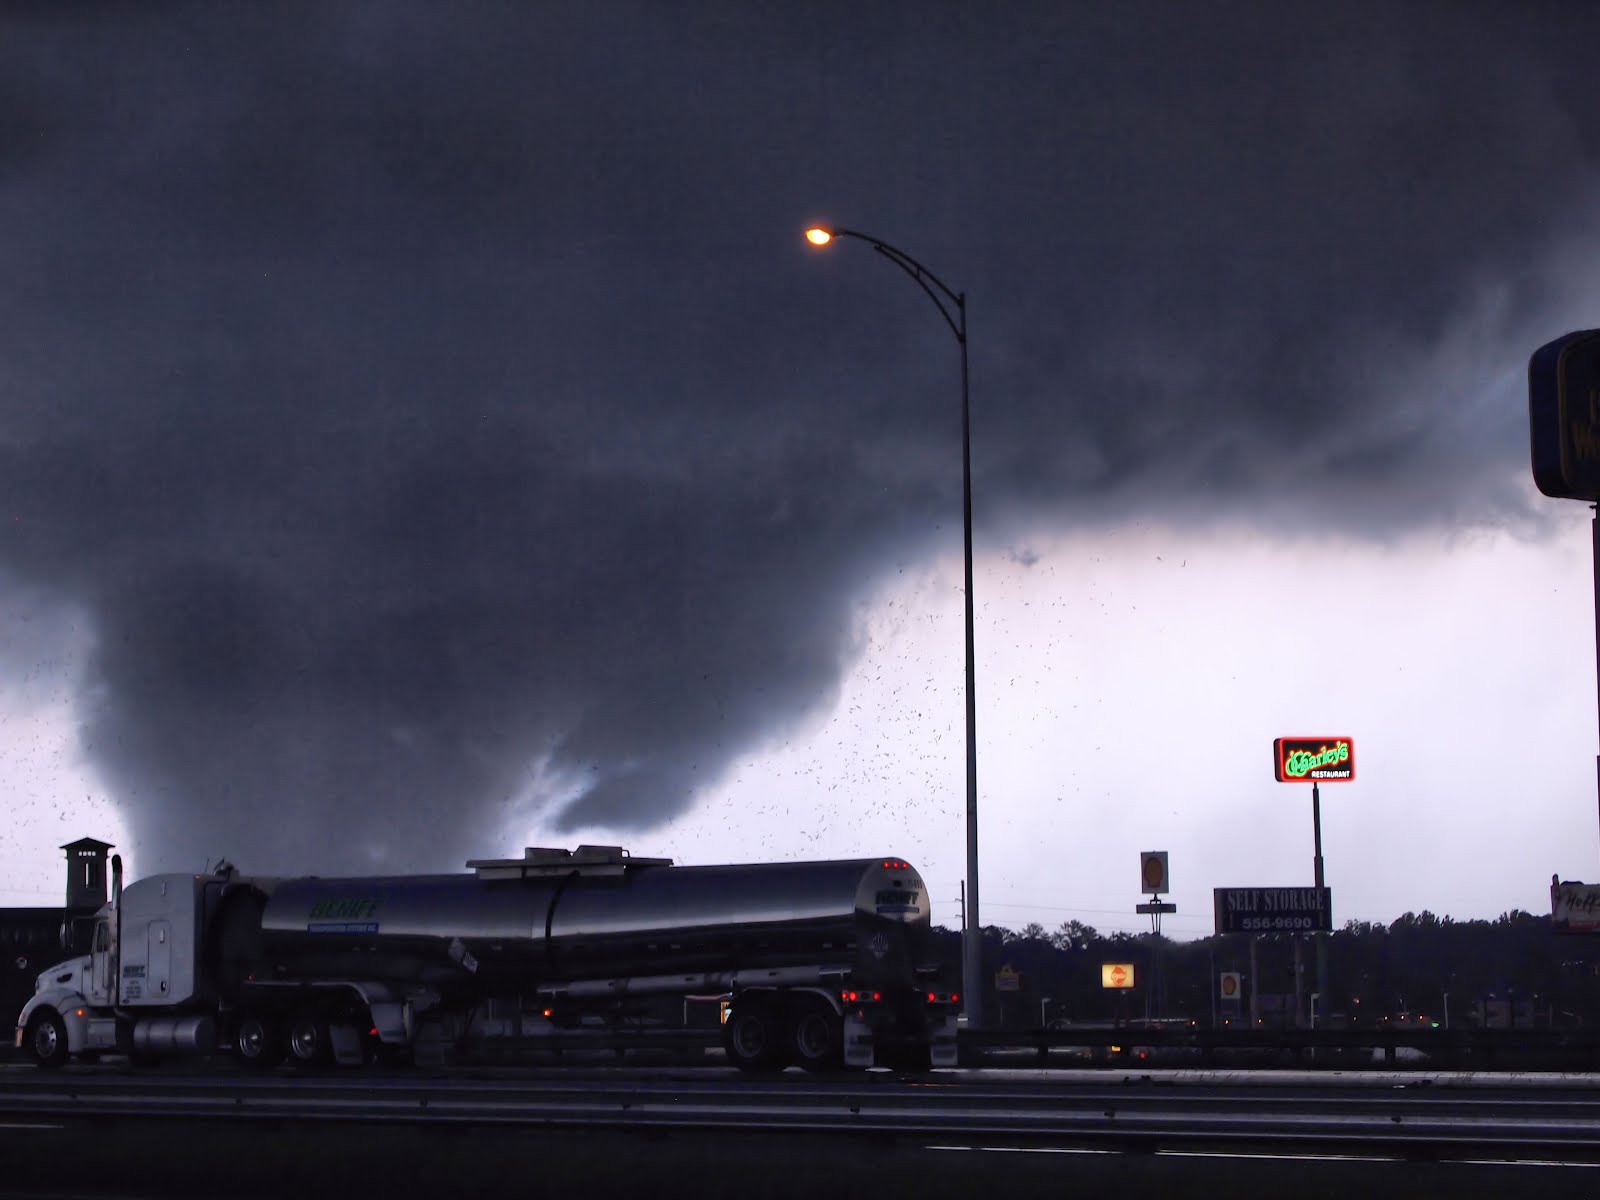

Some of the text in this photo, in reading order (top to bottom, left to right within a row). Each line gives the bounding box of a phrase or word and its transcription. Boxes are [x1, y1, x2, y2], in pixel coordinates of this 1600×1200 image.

[1311, 770, 1350, 778] RESTAURANT
[1227, 888, 1324, 911] SELF STORAGE
[1242, 916, 1312, 929] 556-9690
